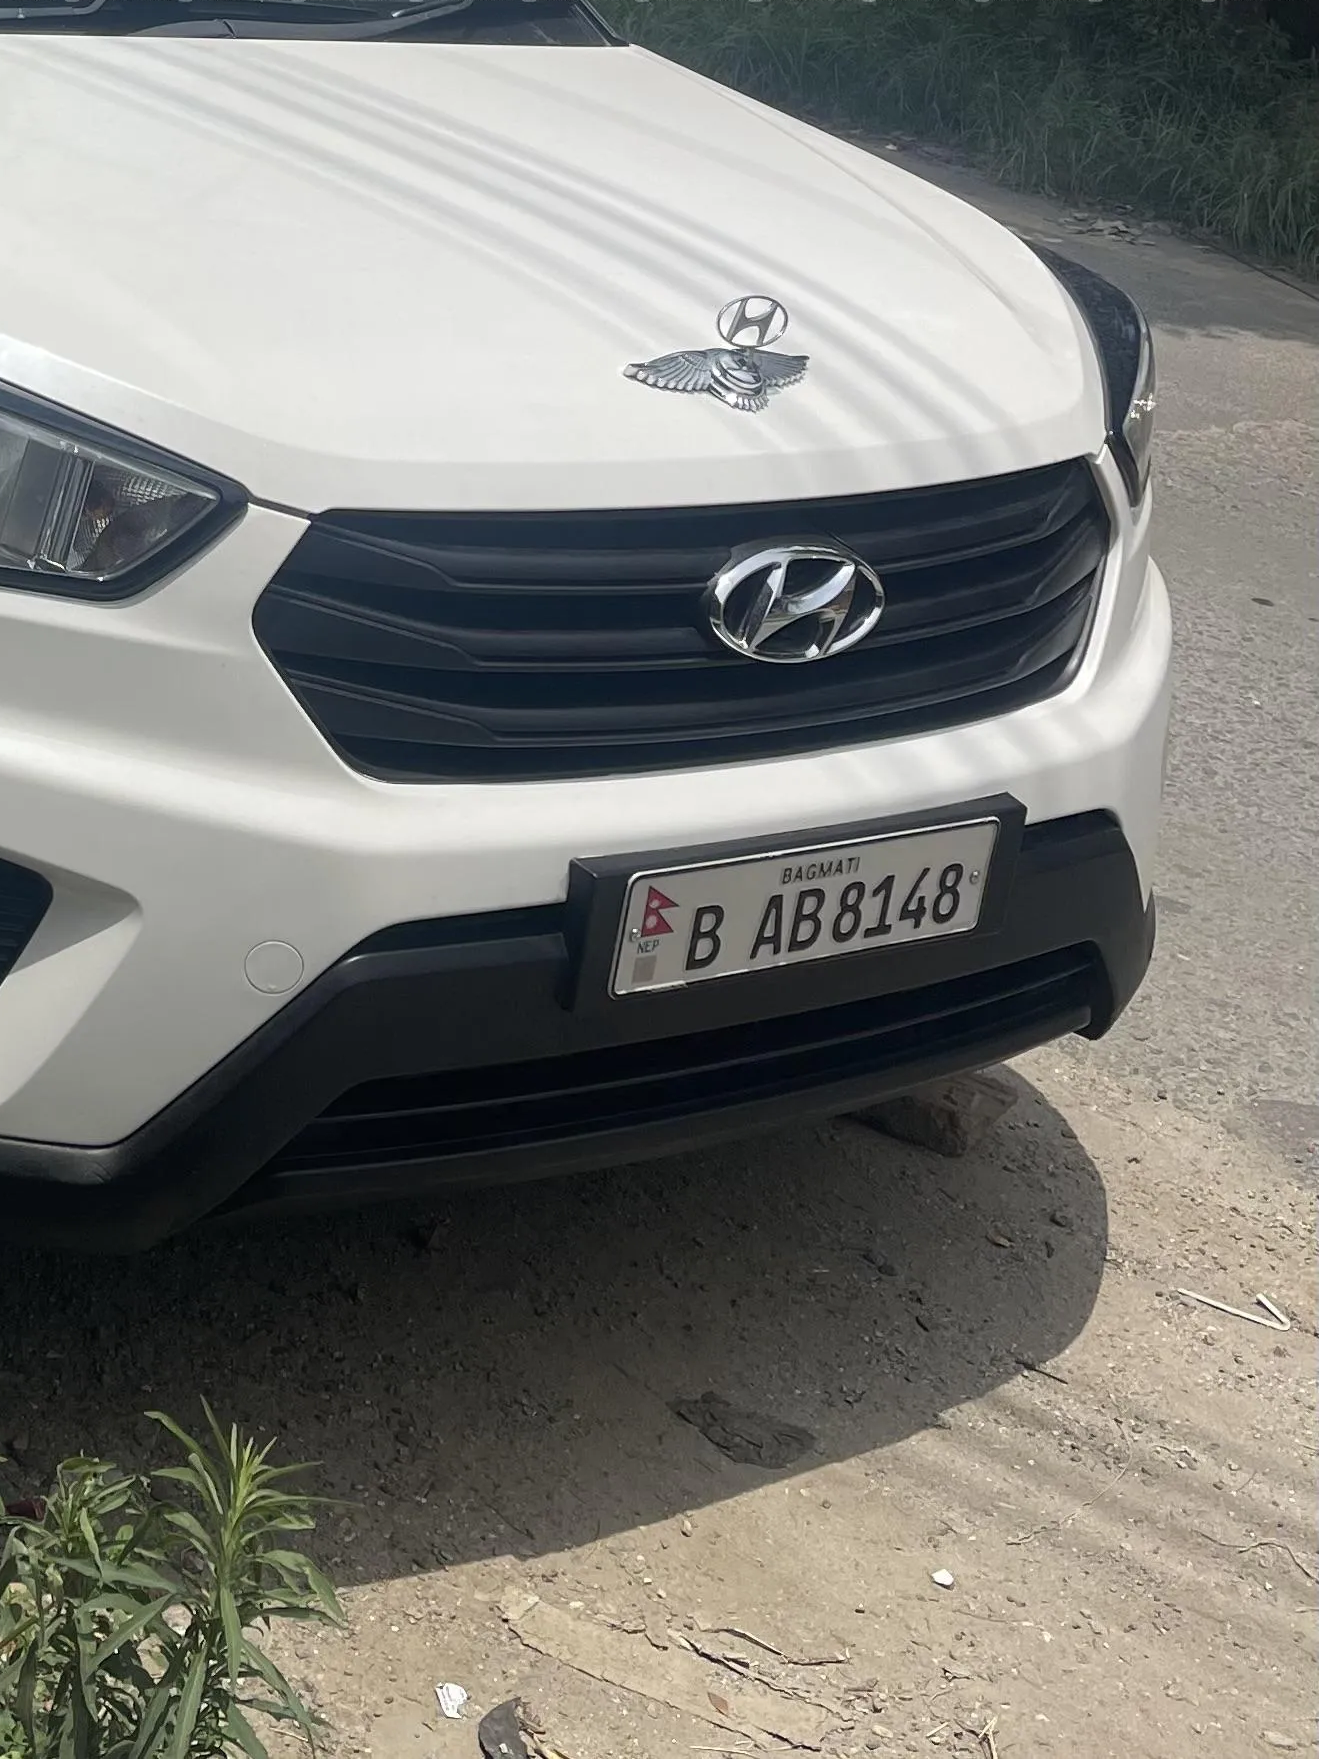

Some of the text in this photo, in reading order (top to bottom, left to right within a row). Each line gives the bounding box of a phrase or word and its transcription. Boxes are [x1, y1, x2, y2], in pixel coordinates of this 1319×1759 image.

[782, 857, 861, 885] BAGMATI
[685, 863, 964, 970] B AB8148
[637, 939, 660, 954] NEP
